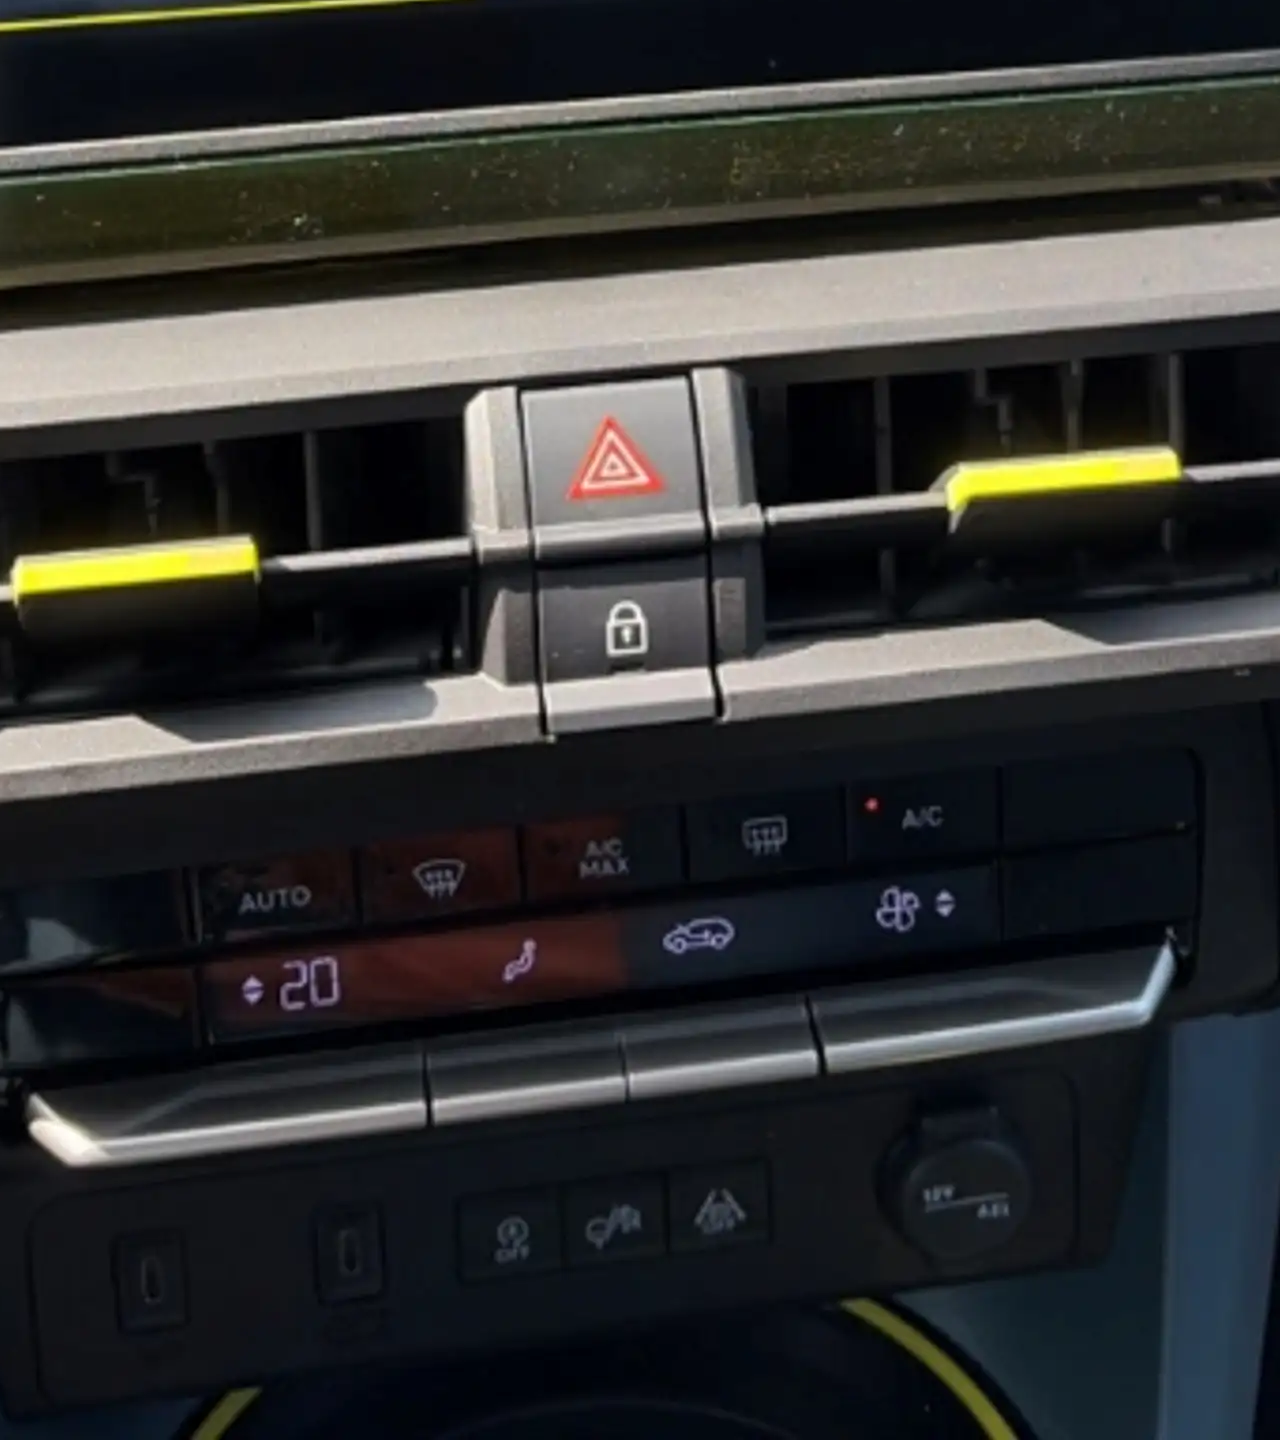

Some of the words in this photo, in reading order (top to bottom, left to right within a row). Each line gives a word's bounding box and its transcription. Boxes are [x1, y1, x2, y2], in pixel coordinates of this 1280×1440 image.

[902, 805, 945, 830] A/C
[585, 837, 624, 859] A/C
[578, 856, 630, 879] MAX
[238, 885, 312, 916] AUTO
[279, 956, 341, 1013] 20
